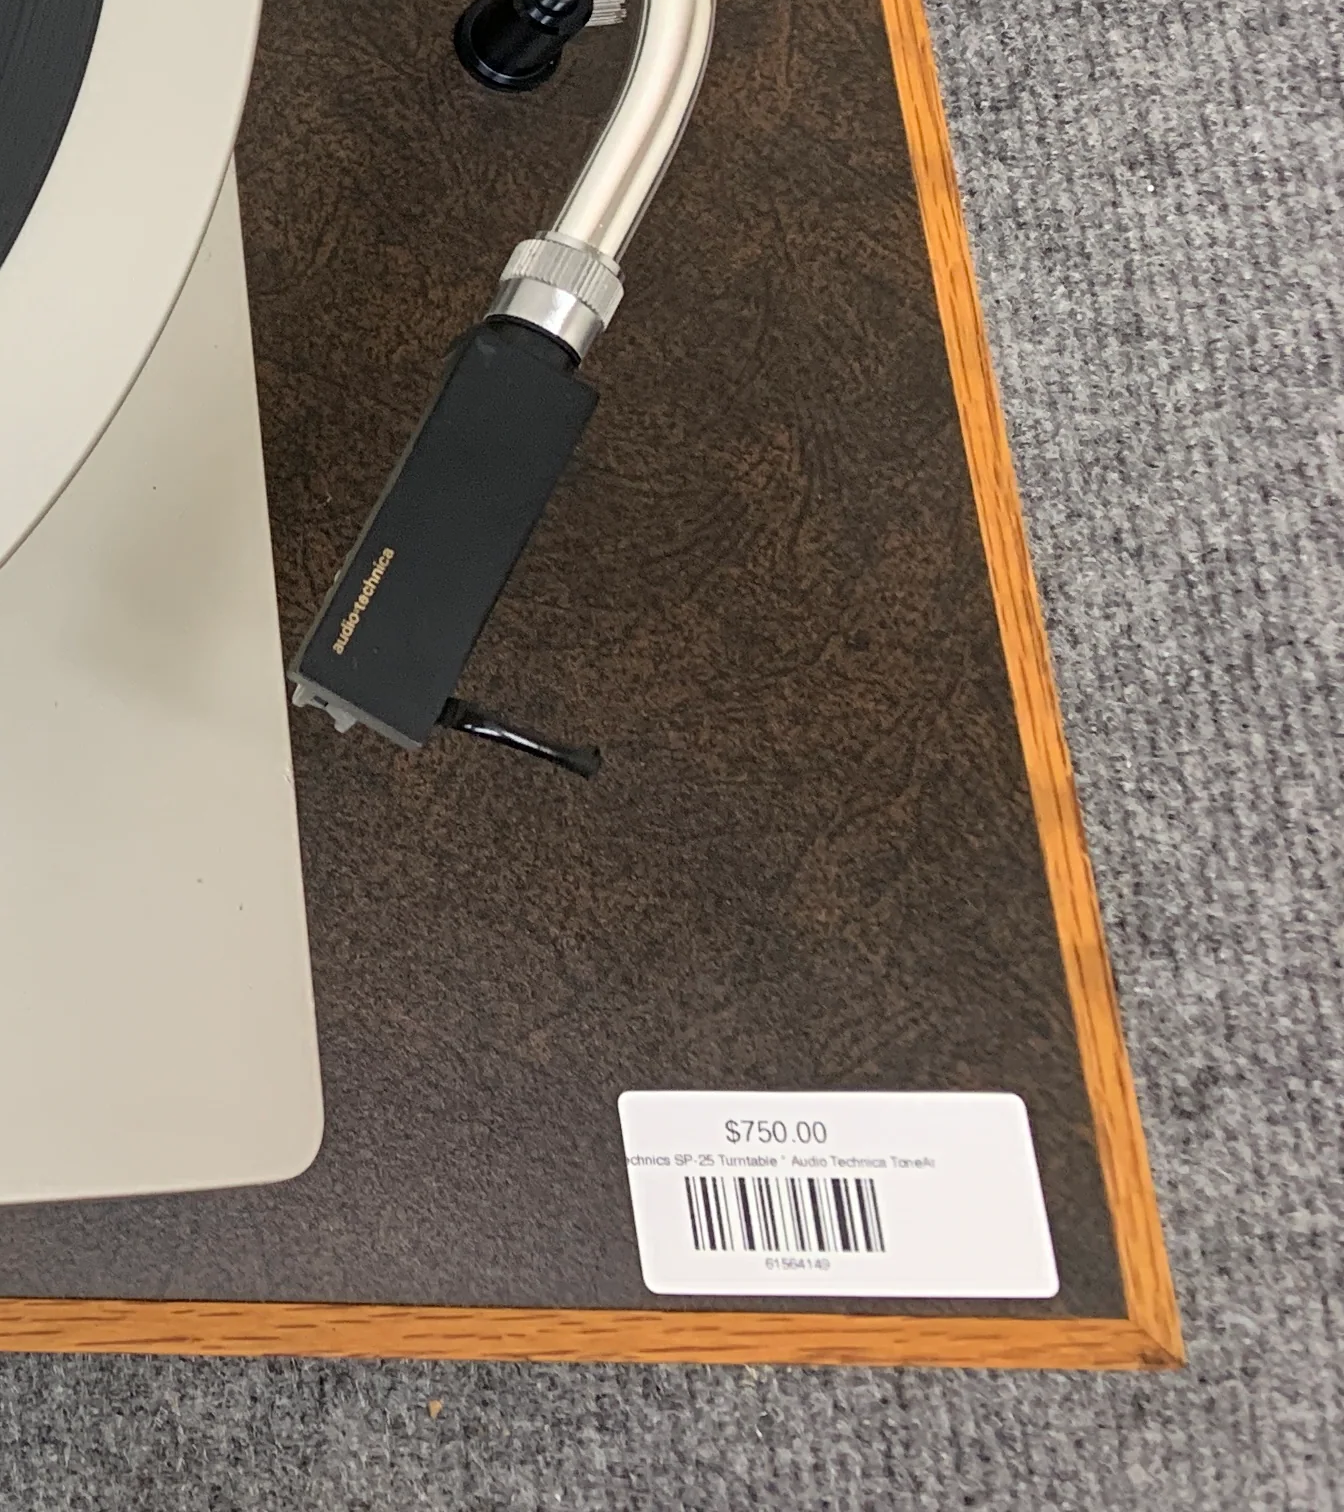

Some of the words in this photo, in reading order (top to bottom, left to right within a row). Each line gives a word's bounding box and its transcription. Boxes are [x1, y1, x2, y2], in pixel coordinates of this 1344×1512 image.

[332, 547, 395, 655] audio-technica
[725, 1119, 827, 1144] $750.00
[717, 1154, 778, 1167] Turntable
[791, 1155, 828, 1168] Audio
